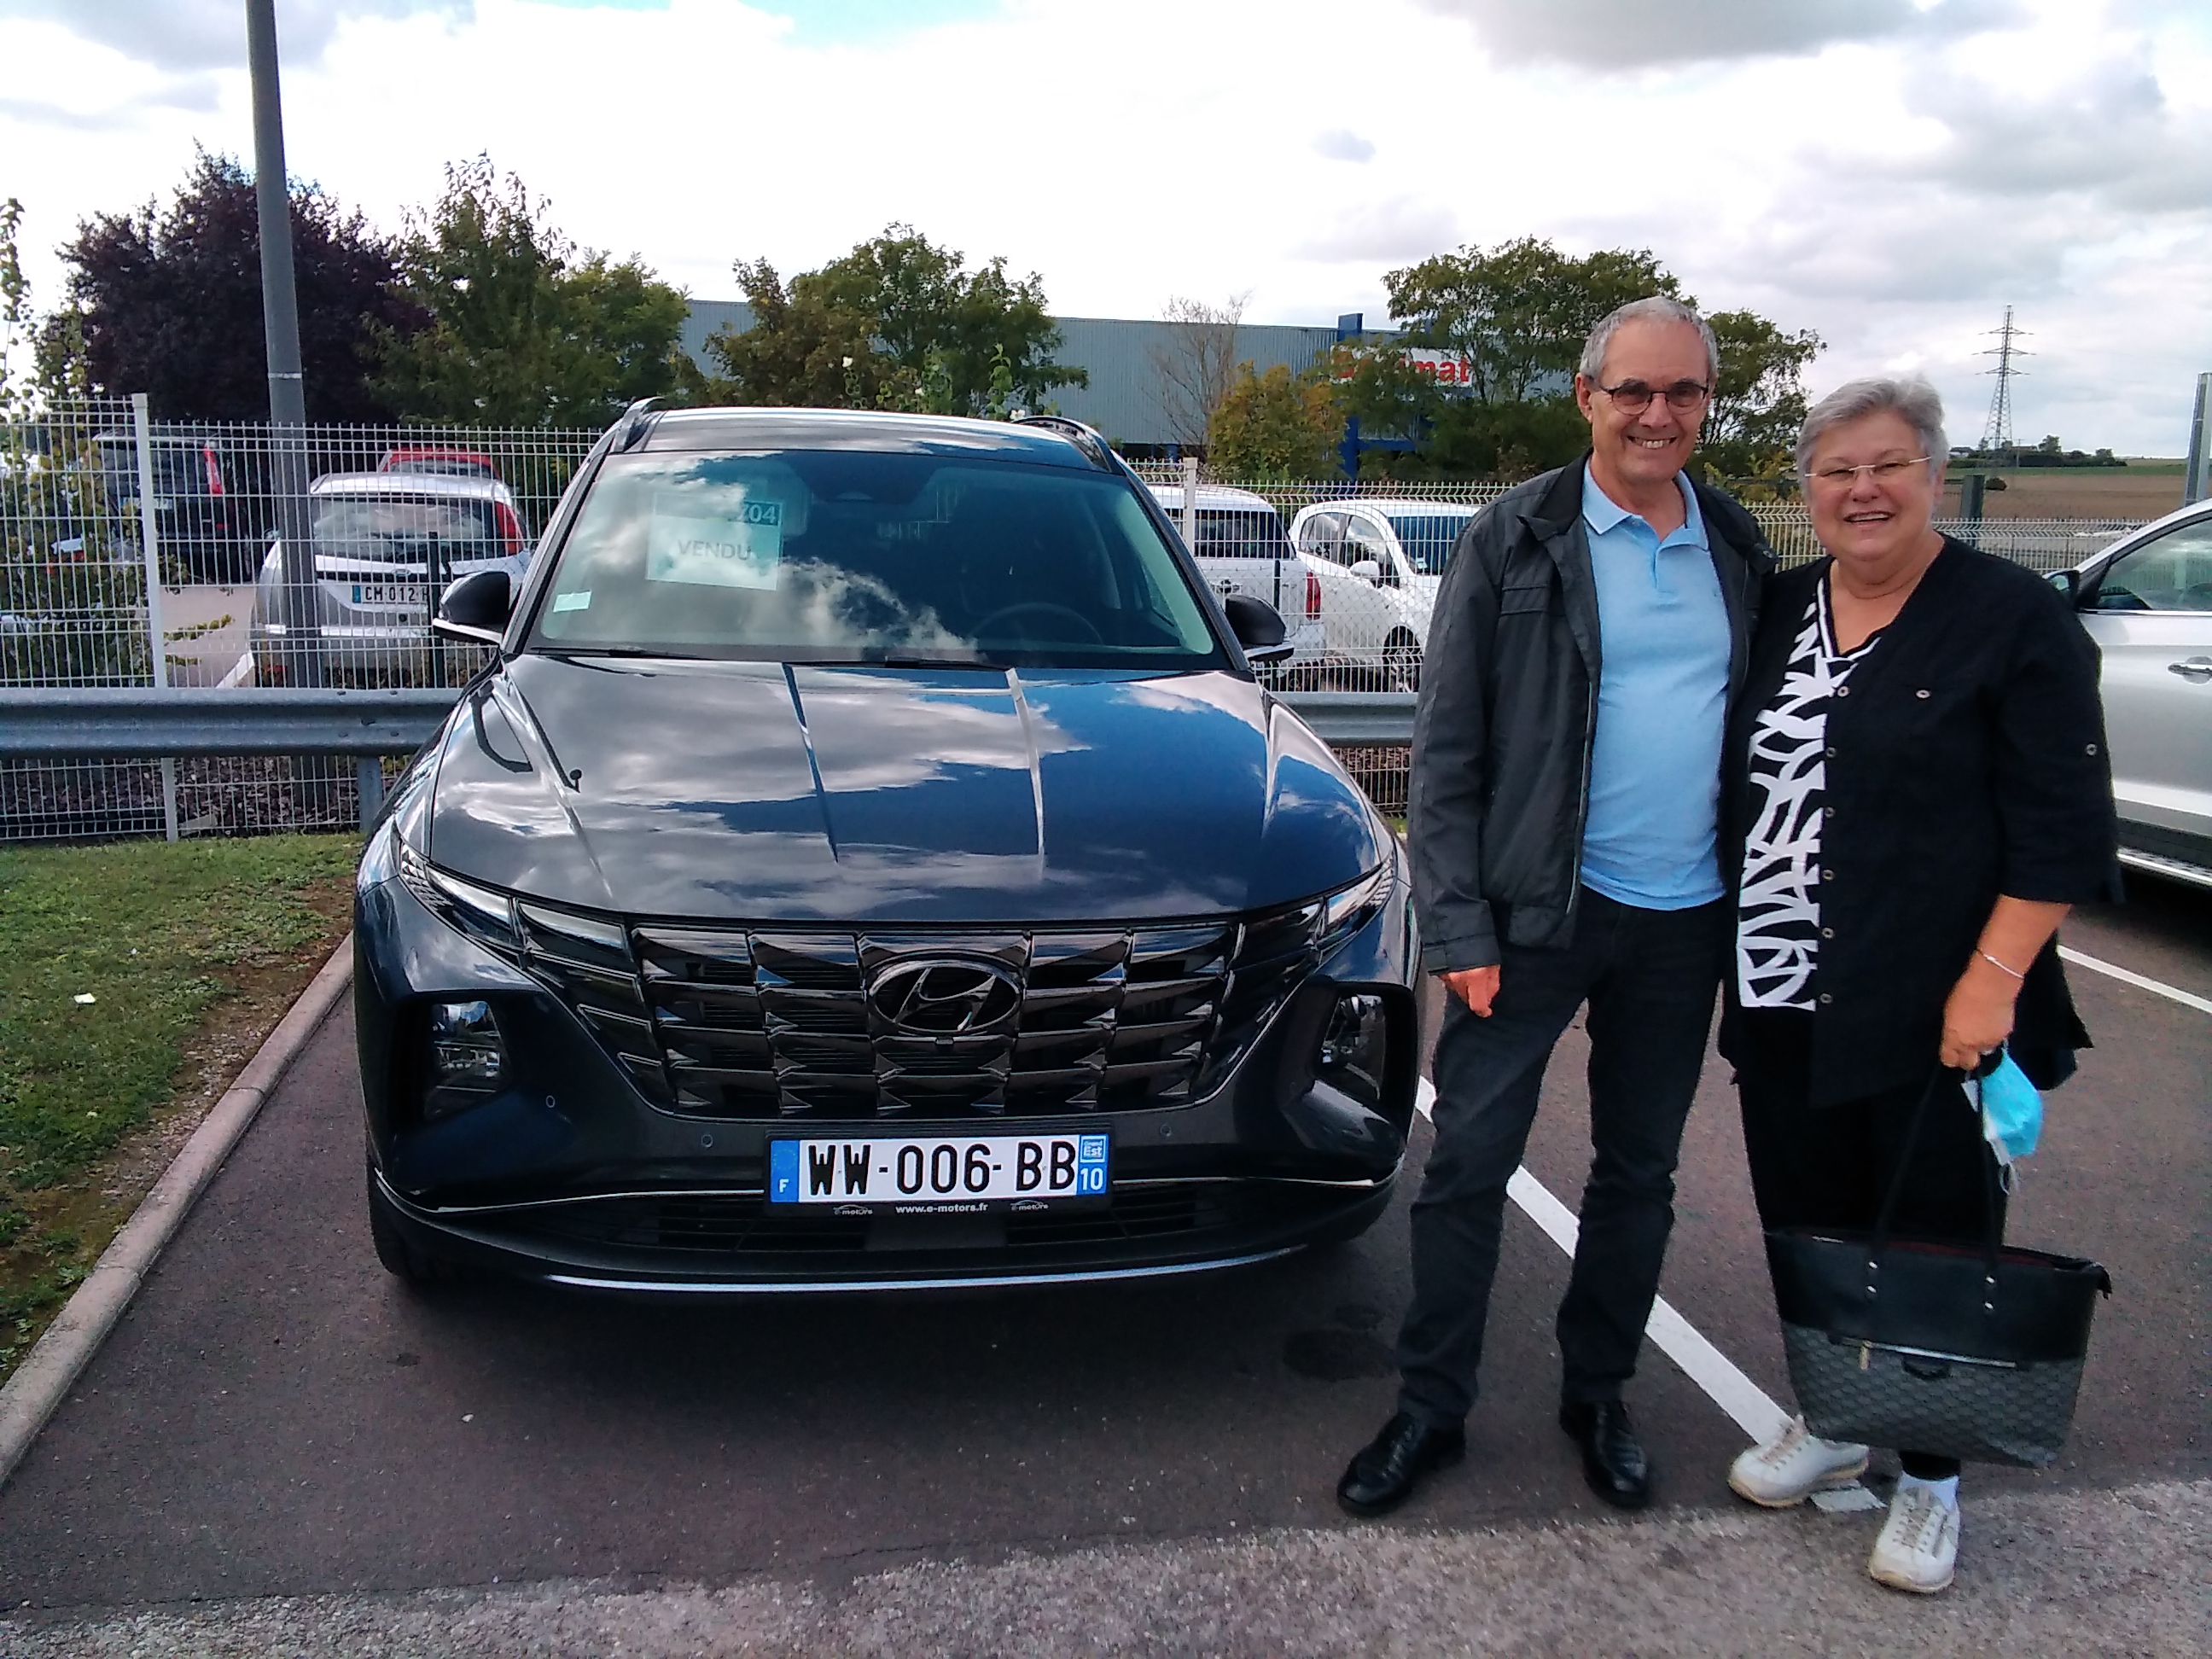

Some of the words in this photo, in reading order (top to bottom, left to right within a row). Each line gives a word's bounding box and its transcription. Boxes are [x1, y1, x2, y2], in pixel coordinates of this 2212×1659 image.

[678, 539, 752, 560] VENDU
[1084, 1146, 1103, 1156] Est
[778, 1179, 789, 1193] F
[1080, 1167, 1103, 1191] 10
[895, 1202, 988, 1214] www.e-motors.fr
